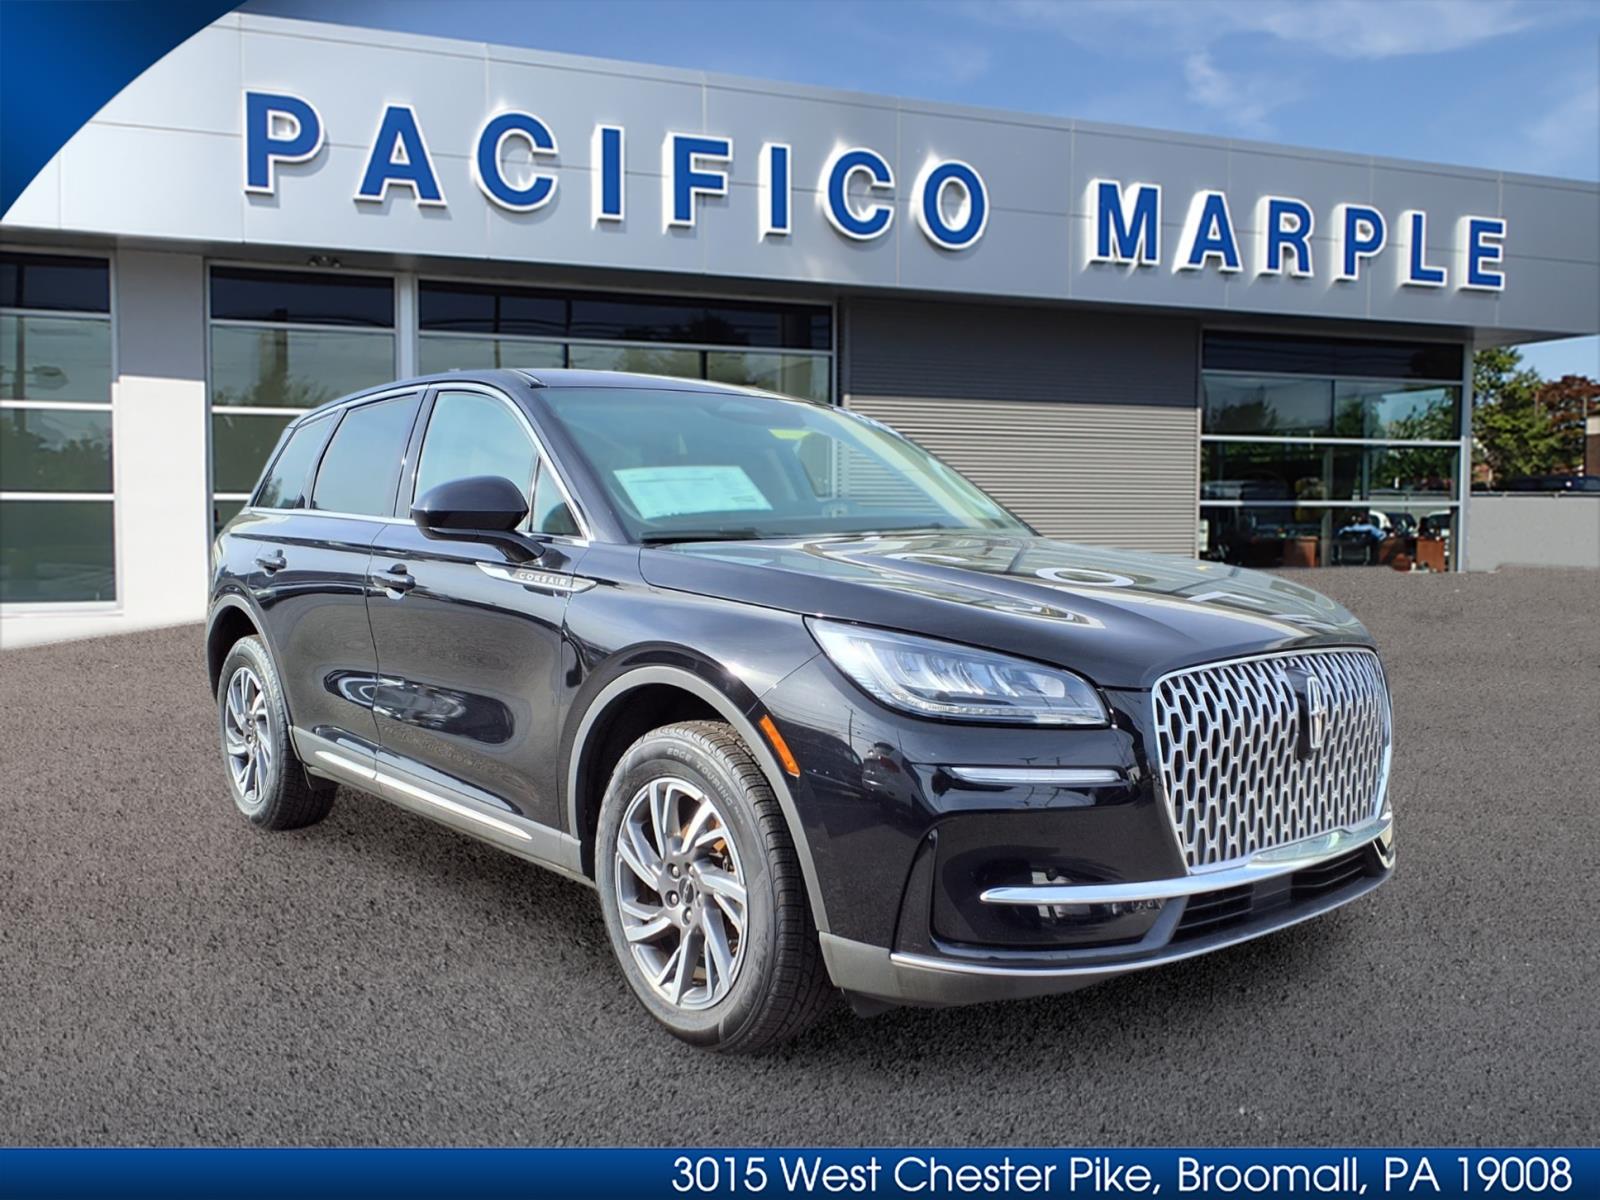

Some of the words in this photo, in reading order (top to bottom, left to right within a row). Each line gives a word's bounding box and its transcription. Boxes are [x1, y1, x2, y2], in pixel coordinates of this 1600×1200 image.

[243, 90, 988, 249] PACIFICO
[1085, 179, 1507, 292] MARPLE
[519, 571, 567, 587] CORSAIR
